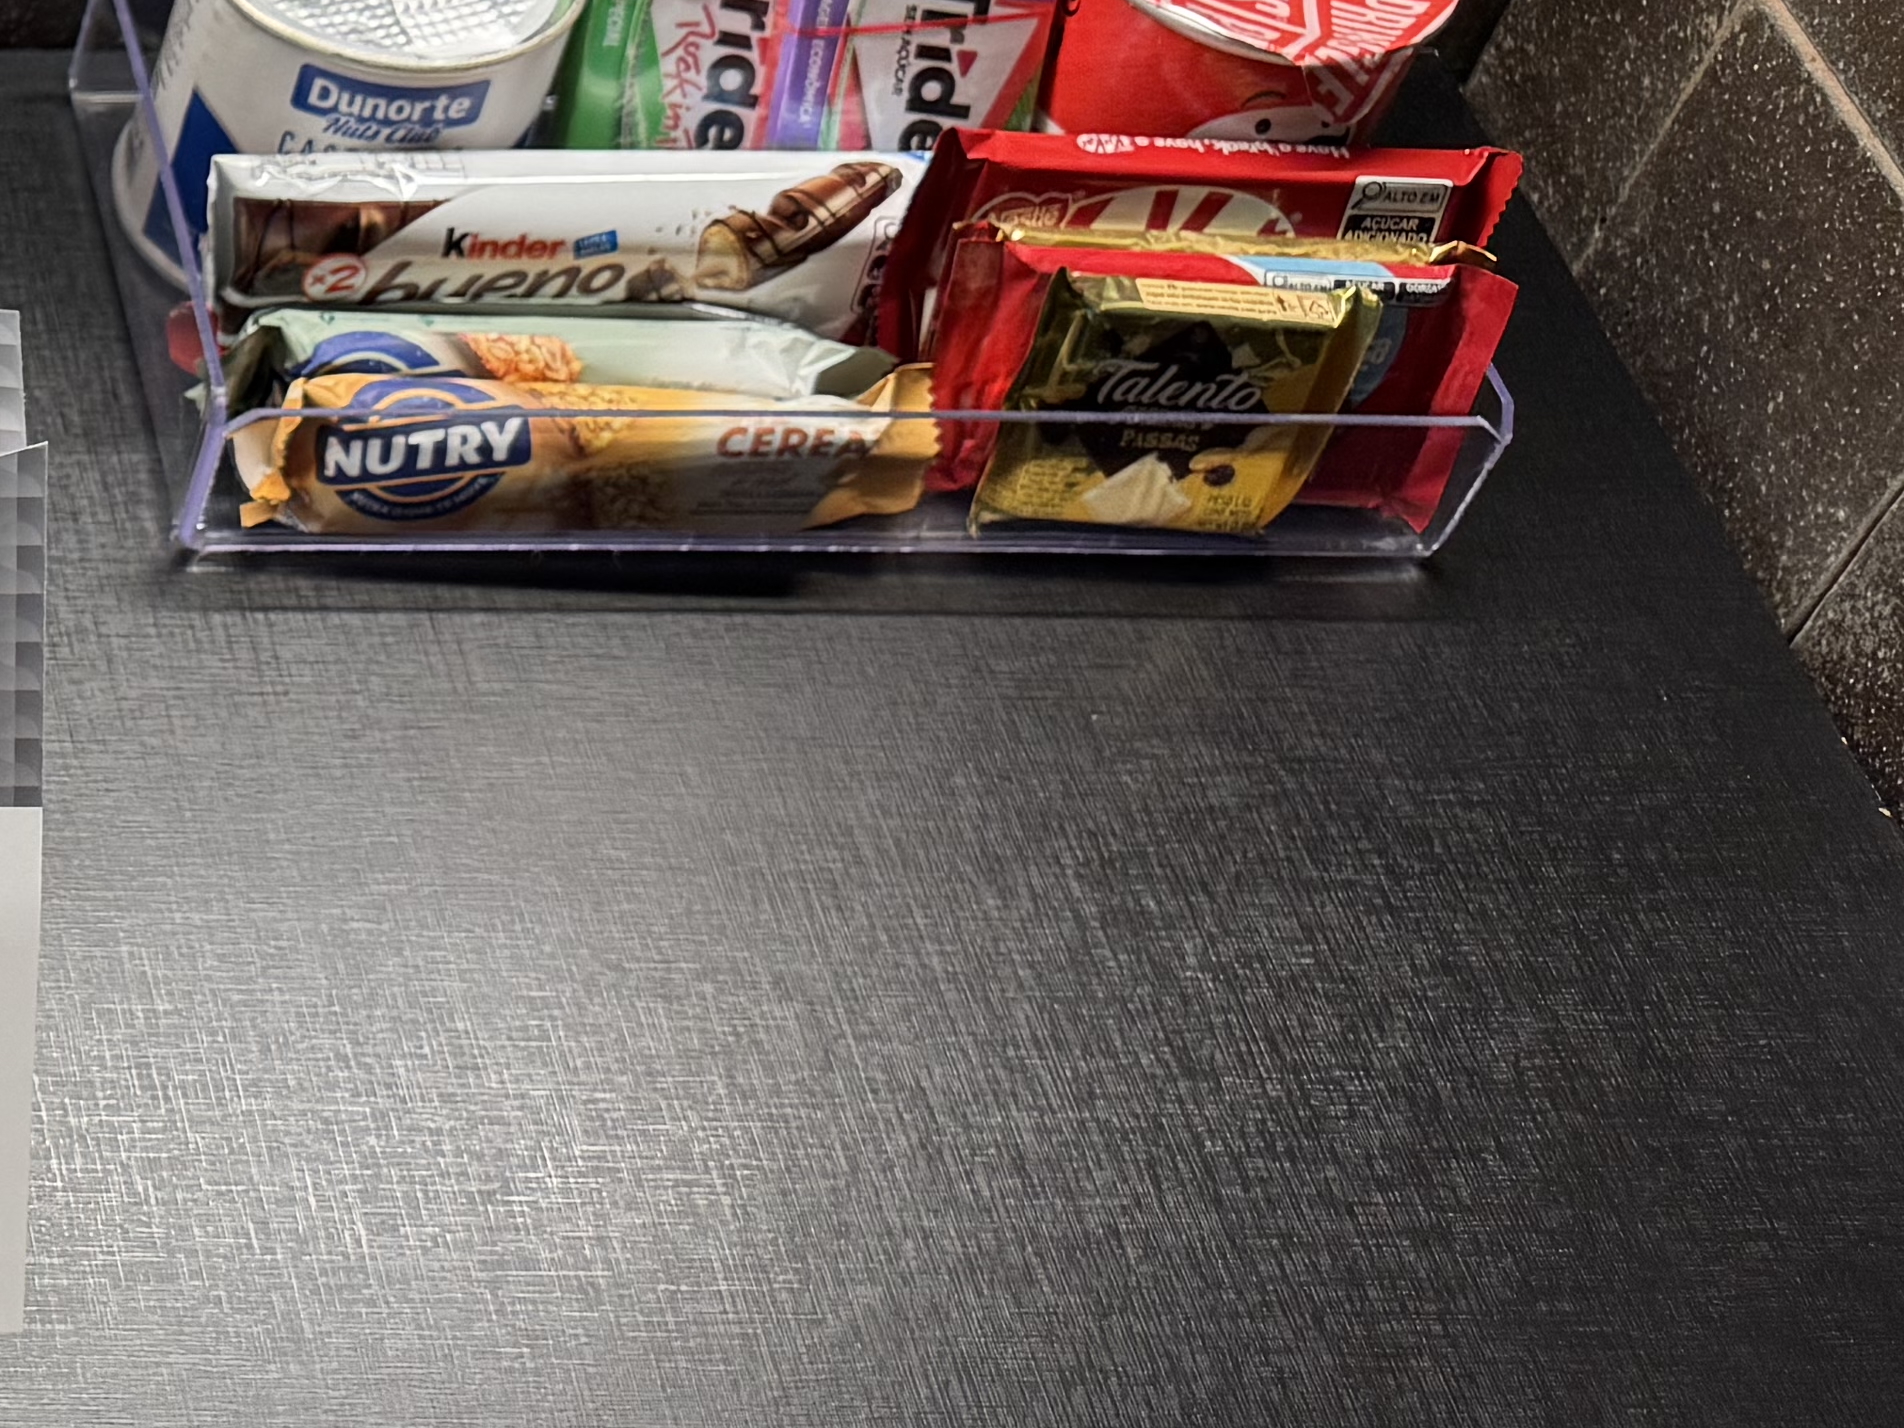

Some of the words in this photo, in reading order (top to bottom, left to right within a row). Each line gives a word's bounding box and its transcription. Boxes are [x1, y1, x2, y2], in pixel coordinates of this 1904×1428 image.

[307, 77, 473, 122] Dunorte
[323, 116, 381, 143] Nuts
[384, 122, 442, 145] Club
[1154, 136, 1205, 153] have
[1383, 190, 1417, 203] ALTO
[1419, 191, 1440, 204] EM
[1343, 229, 1429, 244] ADICIONADO
[358, 260, 627, 305] bueno
[1093, 359, 1262, 411] Talento
[324, 417, 525, 478] NUTRY
[716, 426, 872, 460] CEREA
